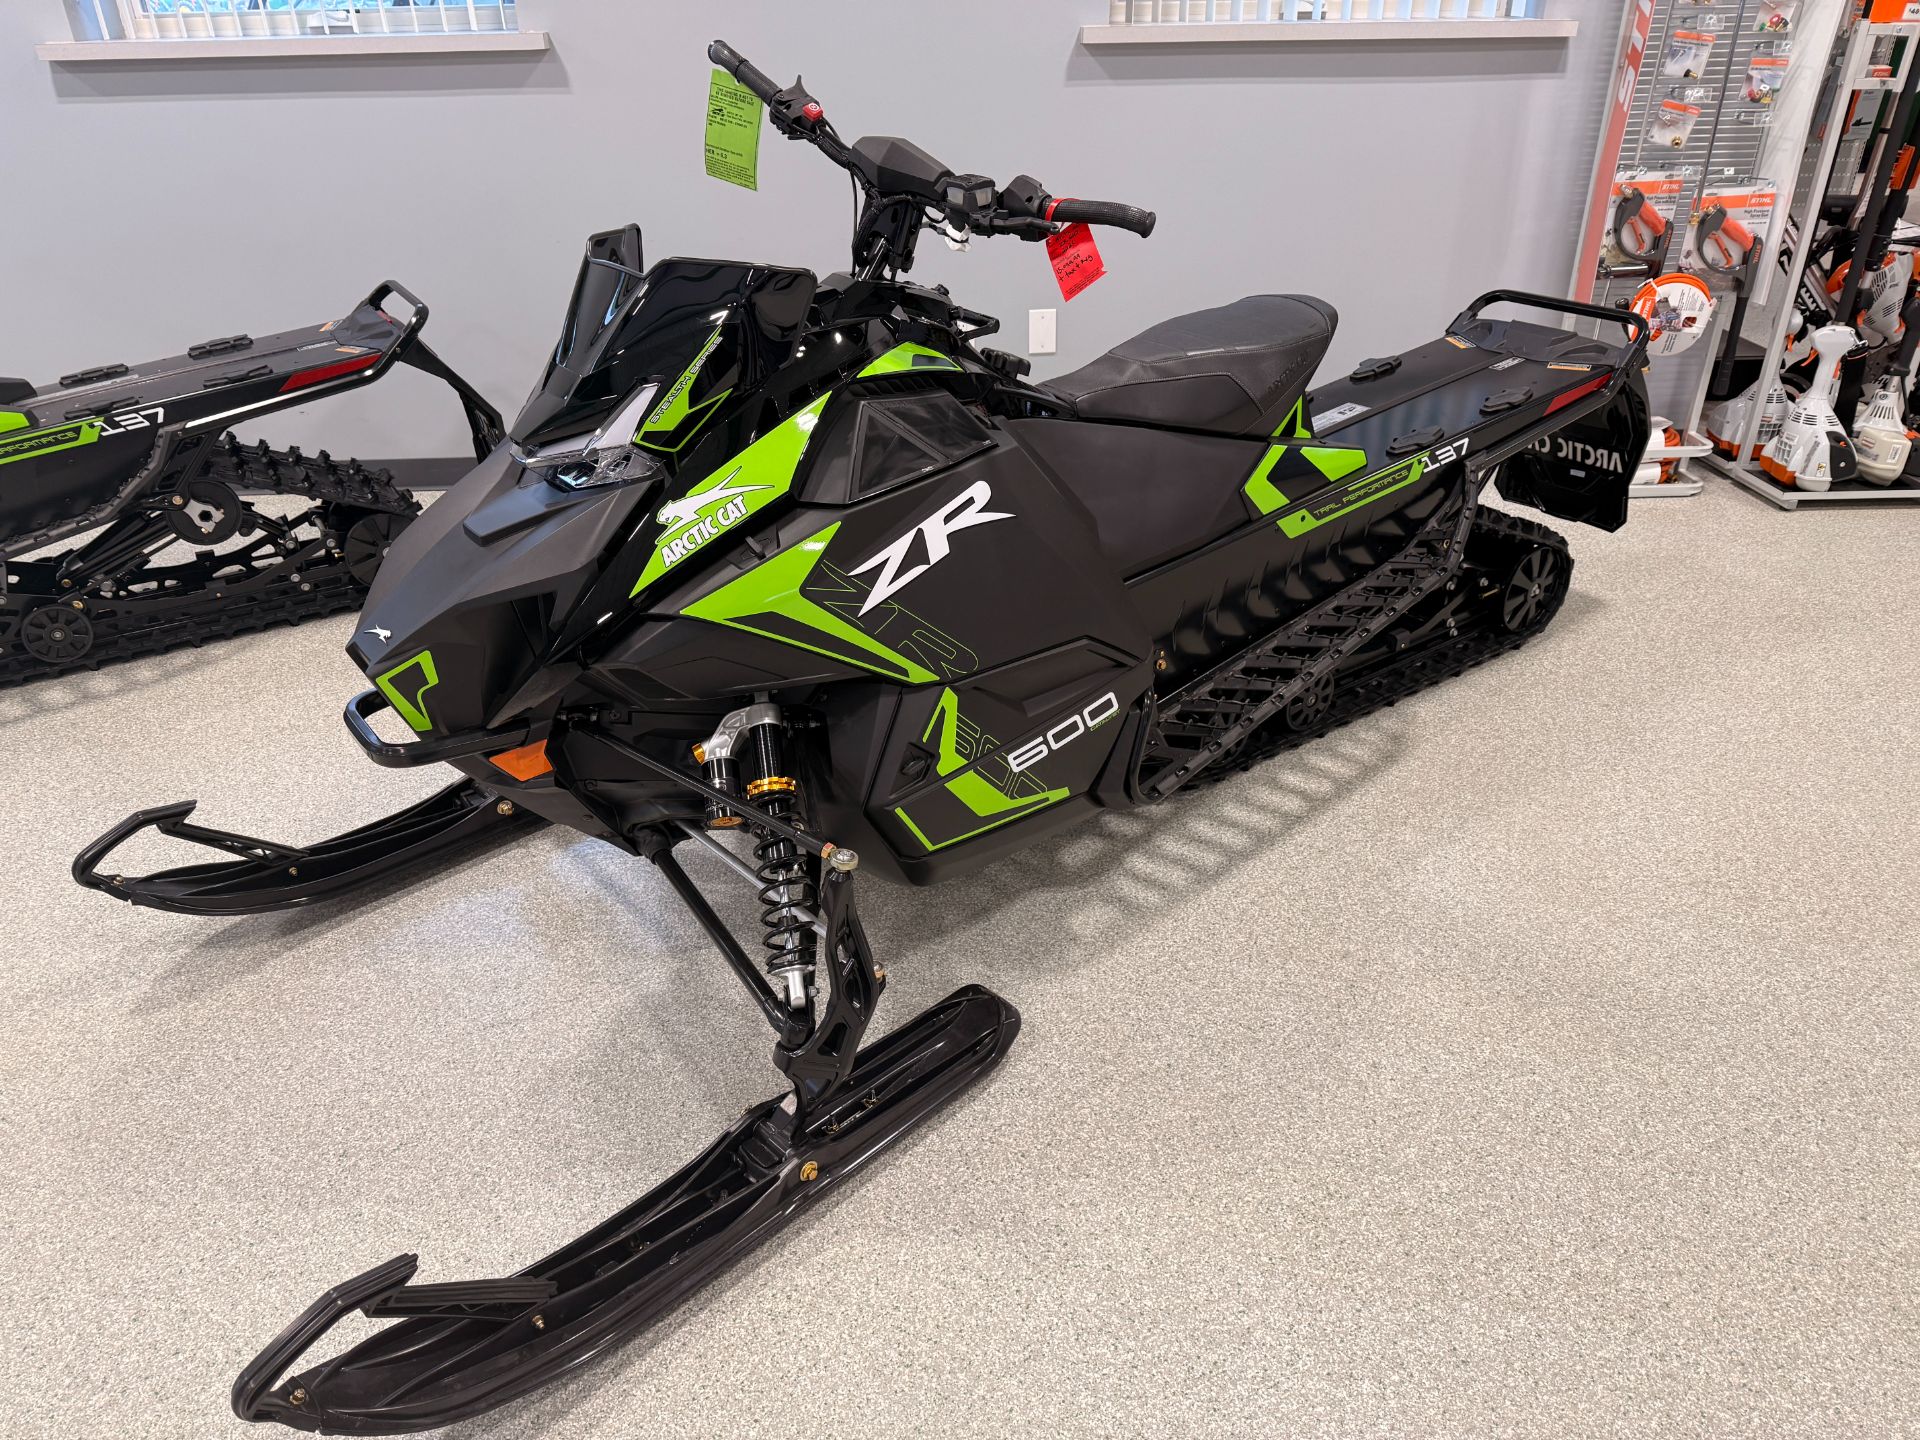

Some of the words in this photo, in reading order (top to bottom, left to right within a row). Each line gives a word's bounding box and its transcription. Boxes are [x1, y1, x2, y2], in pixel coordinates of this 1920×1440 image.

[650, 375, 691, 424] STEALTH
[689, 335, 723, 375] SERIES
[93, 406, 165, 437] 137
[1313, 500, 1341, 516] TRAIL
[1343, 468, 1409, 503] PERFORMANCE
[1421, 437, 1470, 474] 137
[660, 514, 720, 568] ARCTIC
[715, 495, 748, 528] CAT
[847, 480, 1017, 618] ZR
[1007, 691, 1119, 773] 600
